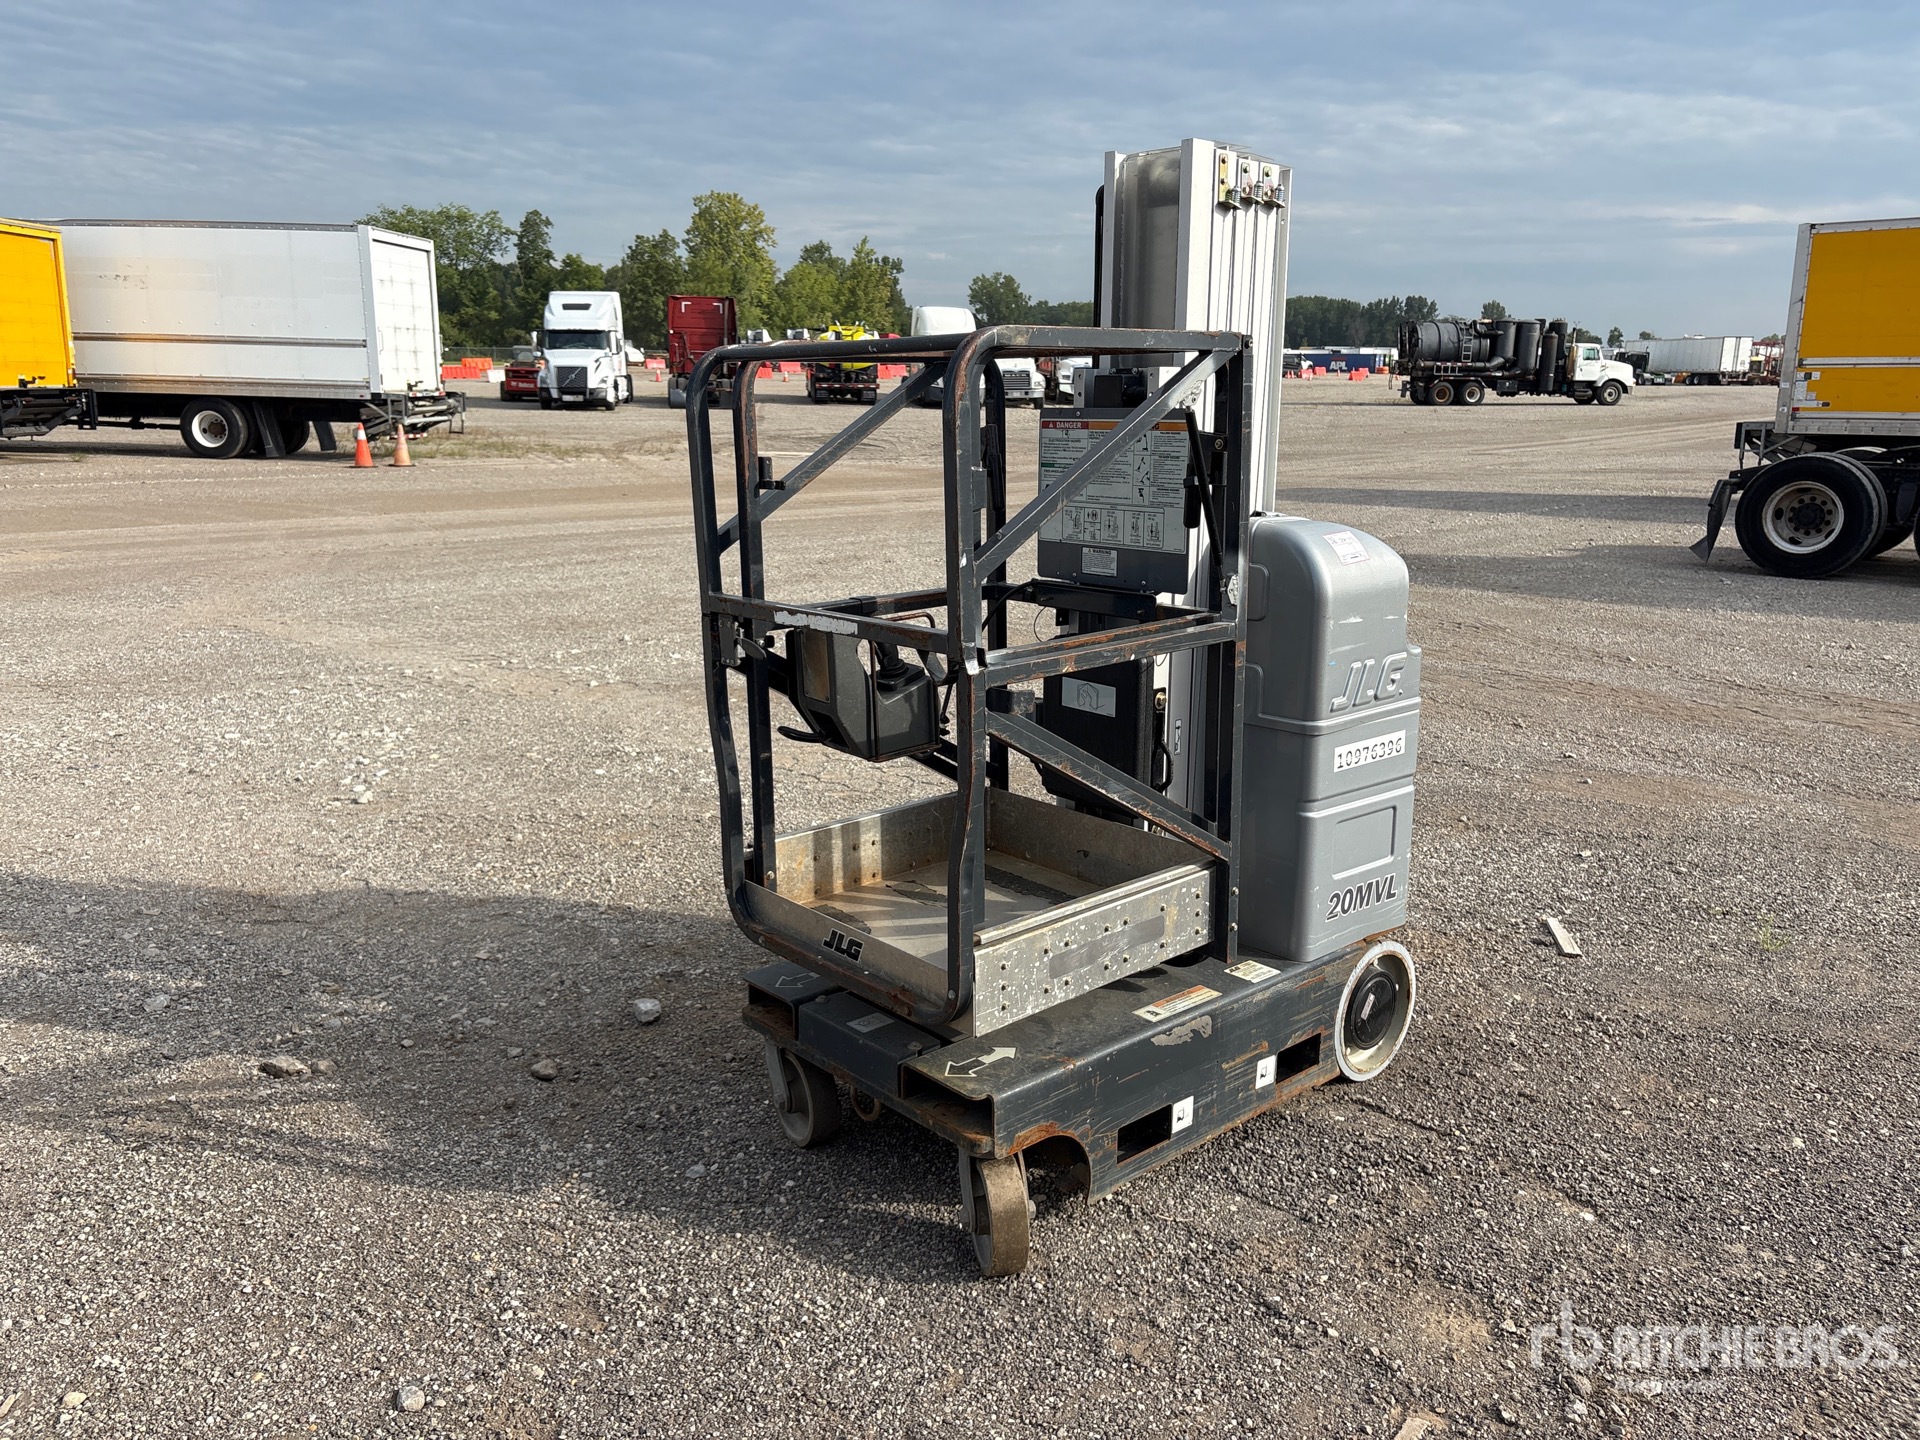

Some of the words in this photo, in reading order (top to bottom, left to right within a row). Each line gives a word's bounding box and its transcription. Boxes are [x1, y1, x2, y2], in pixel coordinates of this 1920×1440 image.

[1329, 361, 1348, 370] APL
[1056, 421, 1082, 429] DANGER
[1330, 652, 1407, 712] JLG
[1336, 737, 1403, 769] 10976396
[1326, 873, 1398, 921] 20MVL
[822, 929, 865, 963] JLG
